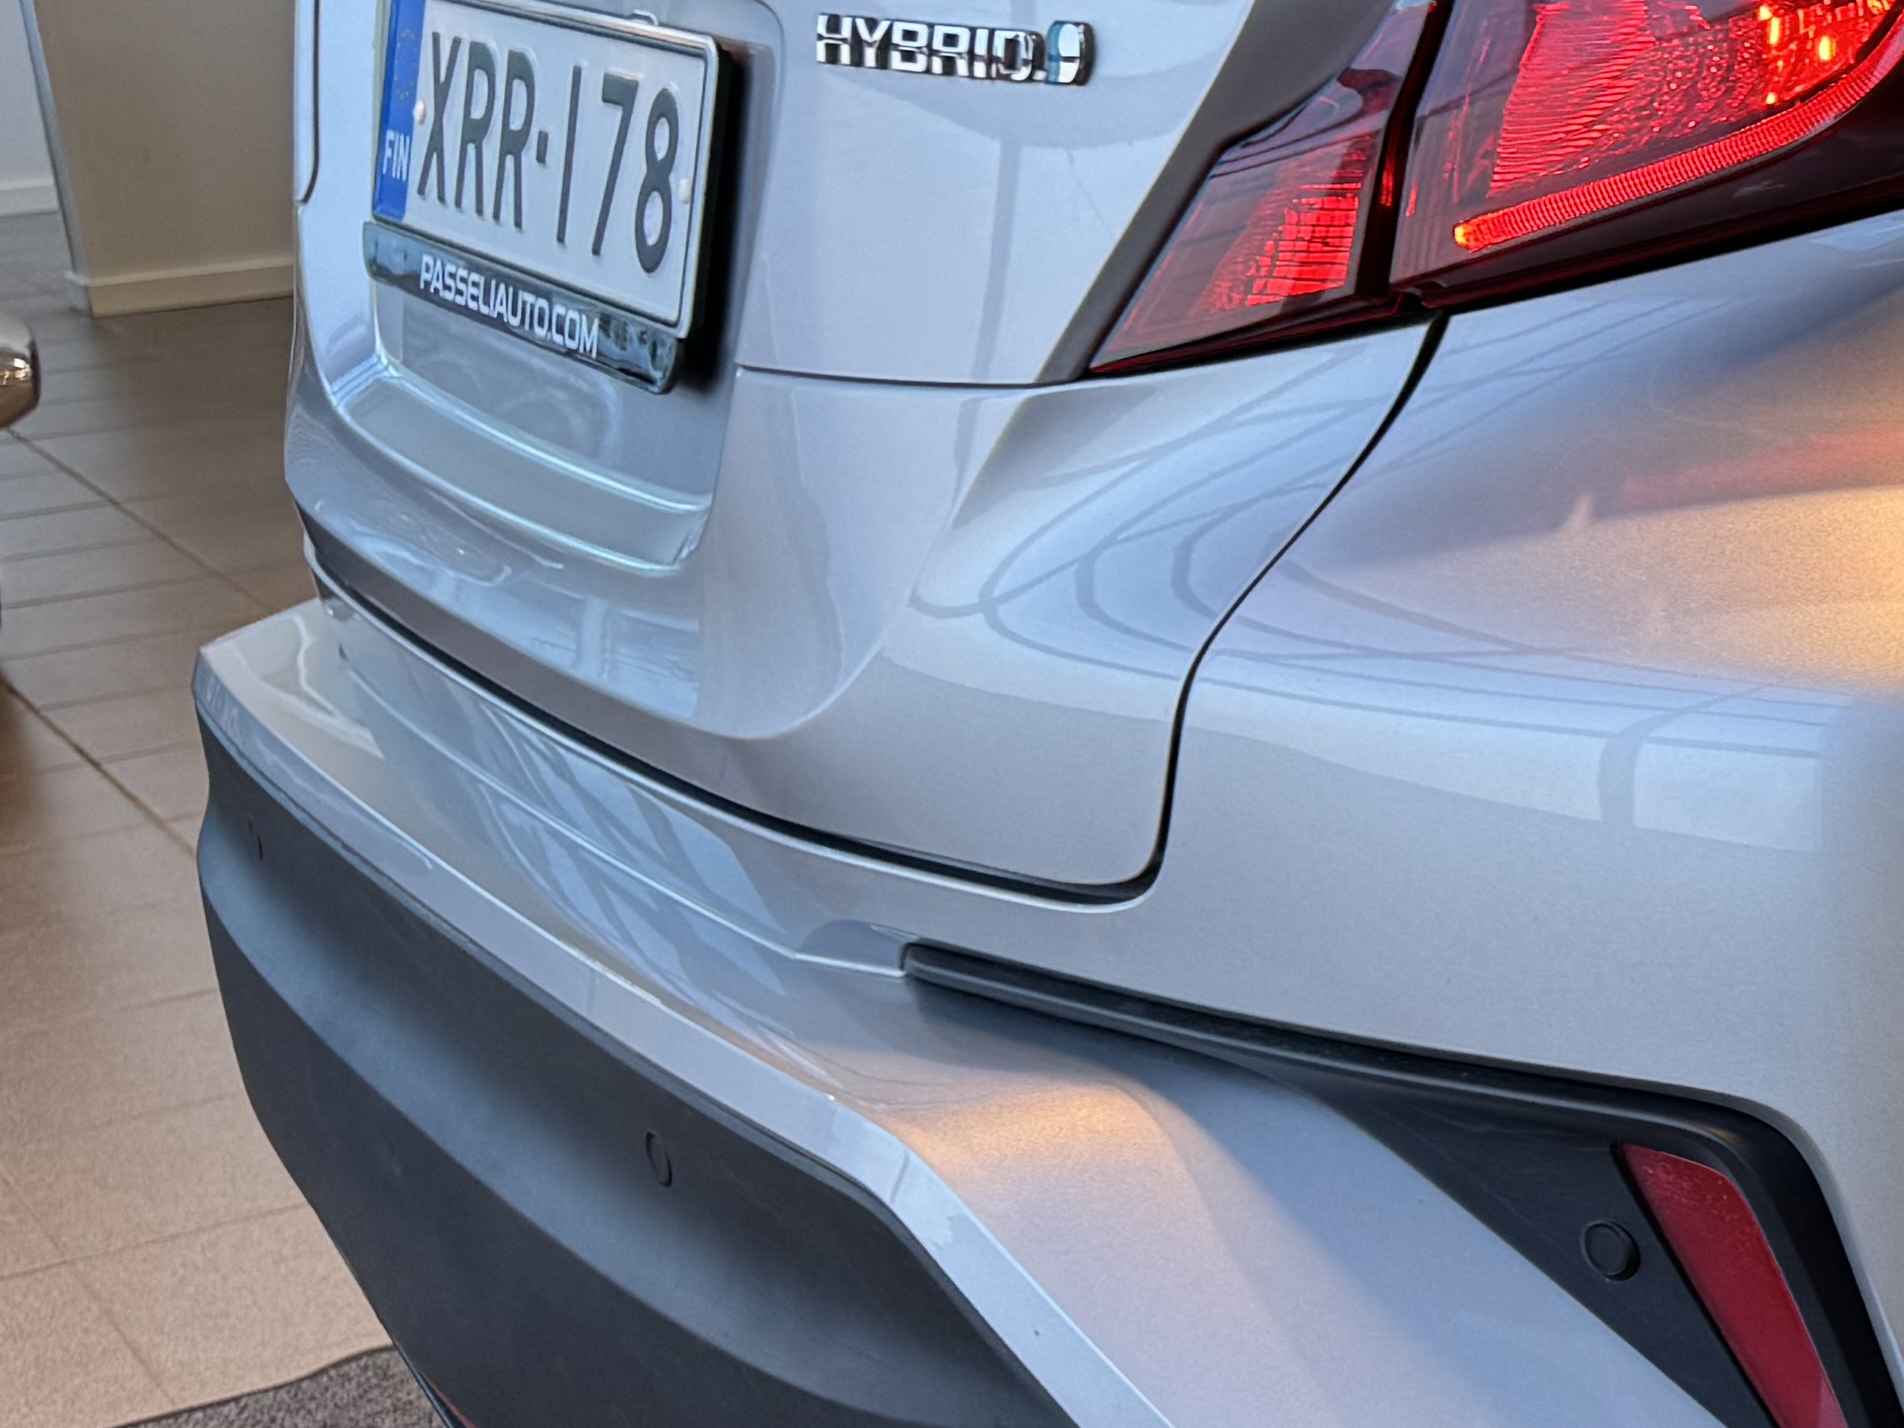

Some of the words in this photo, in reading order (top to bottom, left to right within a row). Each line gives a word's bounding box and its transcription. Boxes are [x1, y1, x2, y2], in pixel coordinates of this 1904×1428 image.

[815, 13, 1034, 83] HYBRID
[382, 129, 411, 182] FIN
[416, 31, 680, 275] XRR-178
[419, 253, 601, 359] PASSELIAUTO.COM
